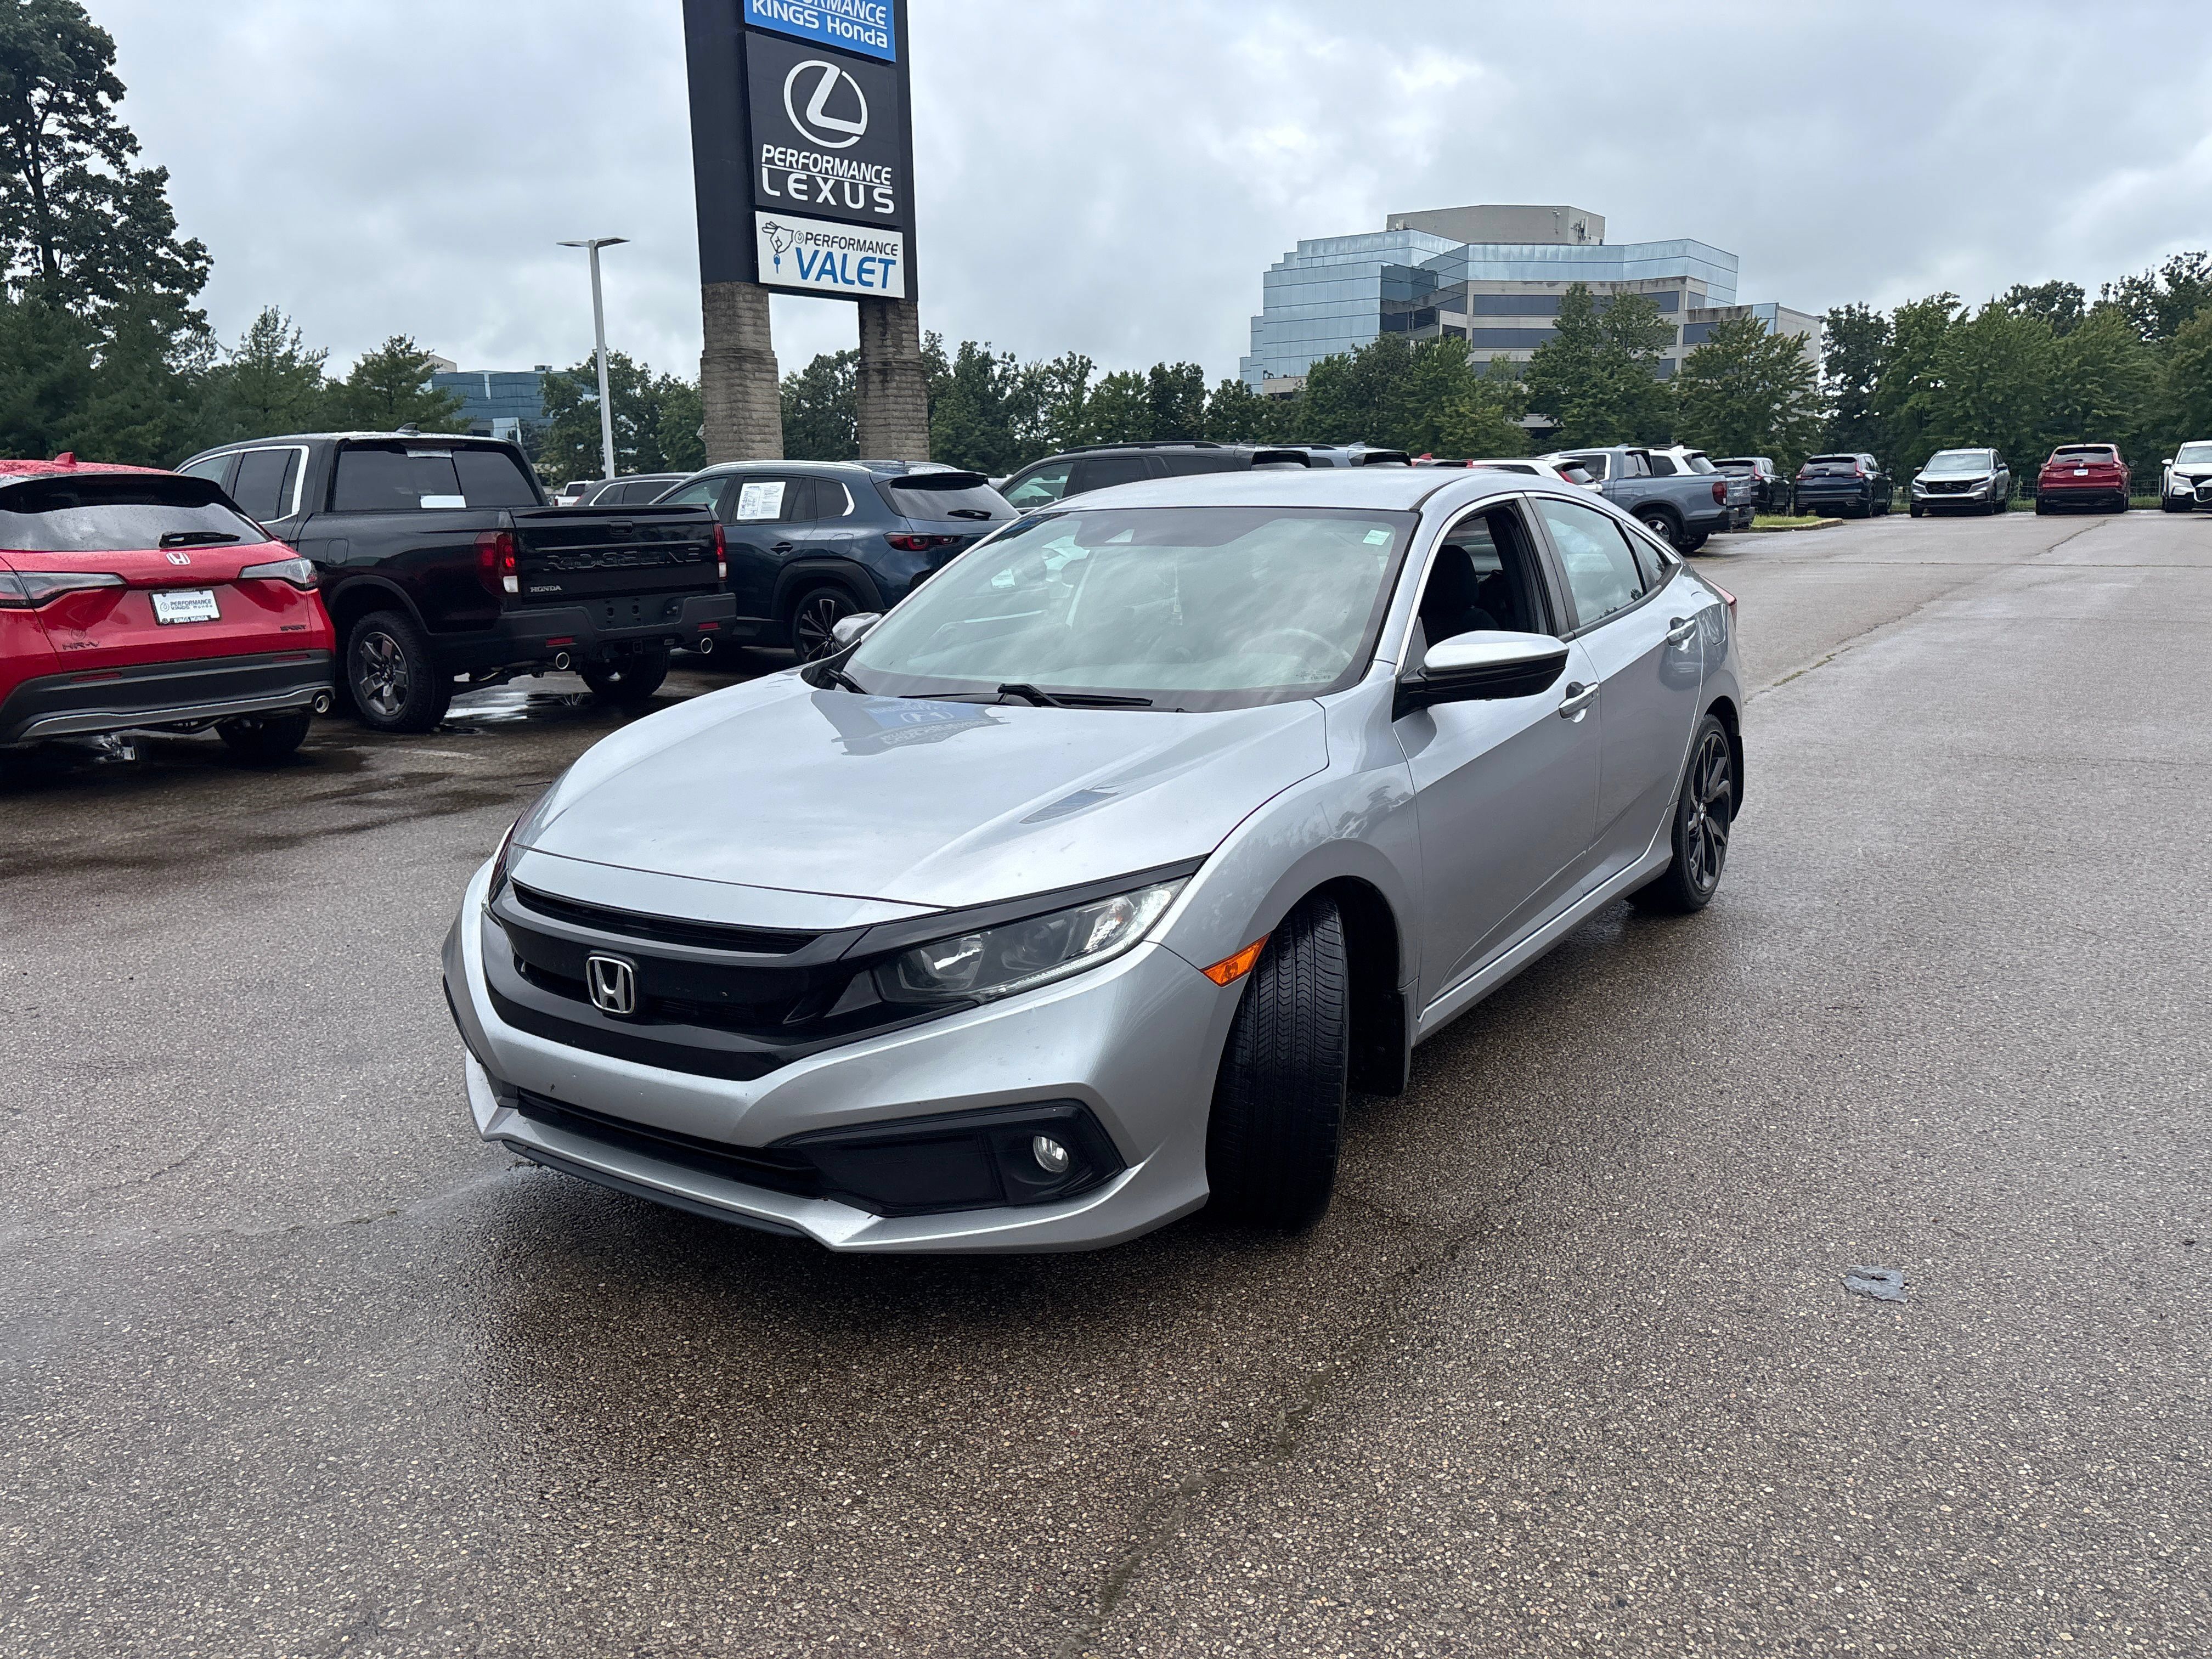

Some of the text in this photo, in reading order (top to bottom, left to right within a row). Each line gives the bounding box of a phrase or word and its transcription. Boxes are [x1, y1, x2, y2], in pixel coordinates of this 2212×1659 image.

[752, 0, 888, 49] KINGS Honda
[761, 144, 893, 185] PERFORMANCE
[761, 167, 895, 214] LEXUS
[804, 232, 899, 257] PERFORMANCE
[795, 247, 896, 289] VALET
